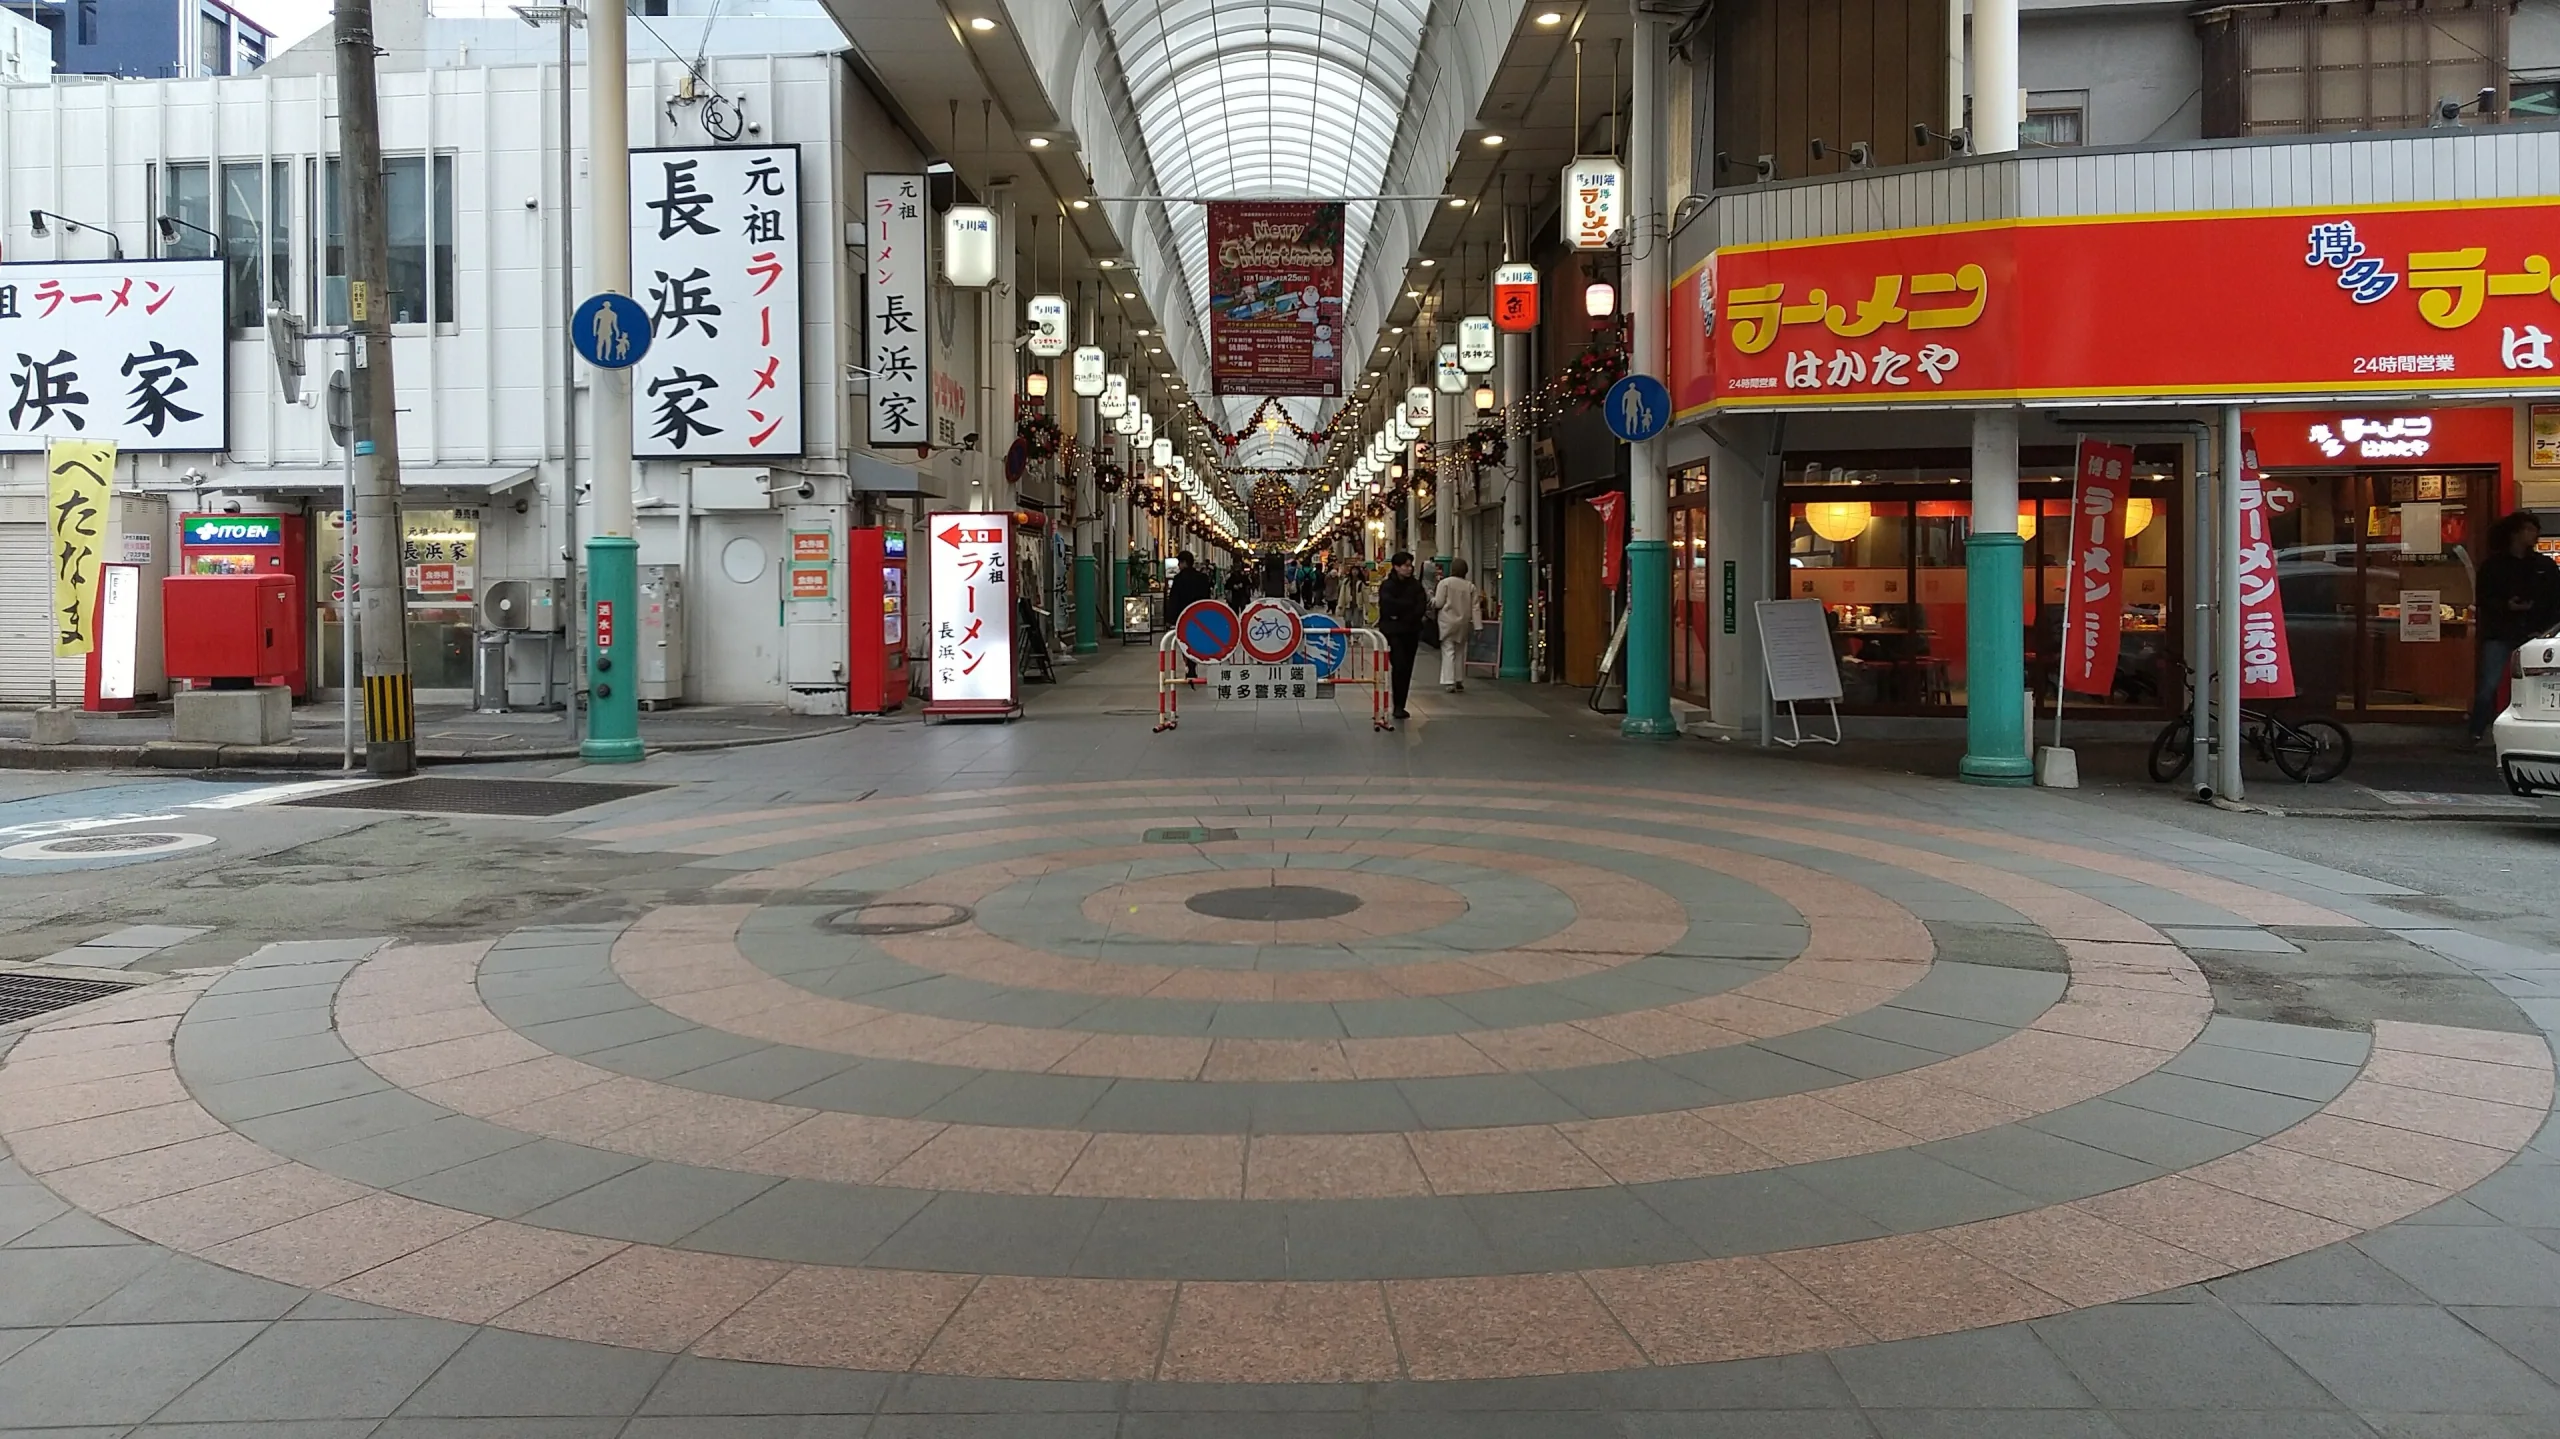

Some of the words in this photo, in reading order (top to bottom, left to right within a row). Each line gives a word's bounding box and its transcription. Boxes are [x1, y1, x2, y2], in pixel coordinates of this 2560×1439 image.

[899, 181, 918, 220] 元祖
[1580, 188, 1609, 246] ラーメン
[875, 198, 894, 286] ラーメン
[1219, 240, 1334, 268] Christmas
[1253, 220, 1305, 243] Merry
[2306, 221, 2398, 303] 博多
[646, 159, 724, 450] 長浜家
[743, 156, 786, 448] 元祖ラーメン
[1727, 264, 1987, 354] ラーメン
[2408, 248, 2560, 328] ラー
[876, 294, 919, 434] 長浜家
[1728, 377, 1778, 389] 24時間営業
[1785, 344, 1959, 388] はかたや
[2353, 355, 2455, 374] 24時間営業
[53, 451, 111, 645] べたなま
[404, 540, 468, 561] 長浜家
[408, 527, 462, 536] 元祖ラーメン
[960, 531, 989, 543] 入口
[2084, 486, 2114, 602] ラーメン
[988, 551, 1006, 584] 元祖
[598, 604, 610, 645] 送水口
[957, 552, 986, 676] ラーメン
[938, 621, 956, 684] 長浜家
[1217, 683, 1307, 699] 博多警察署
